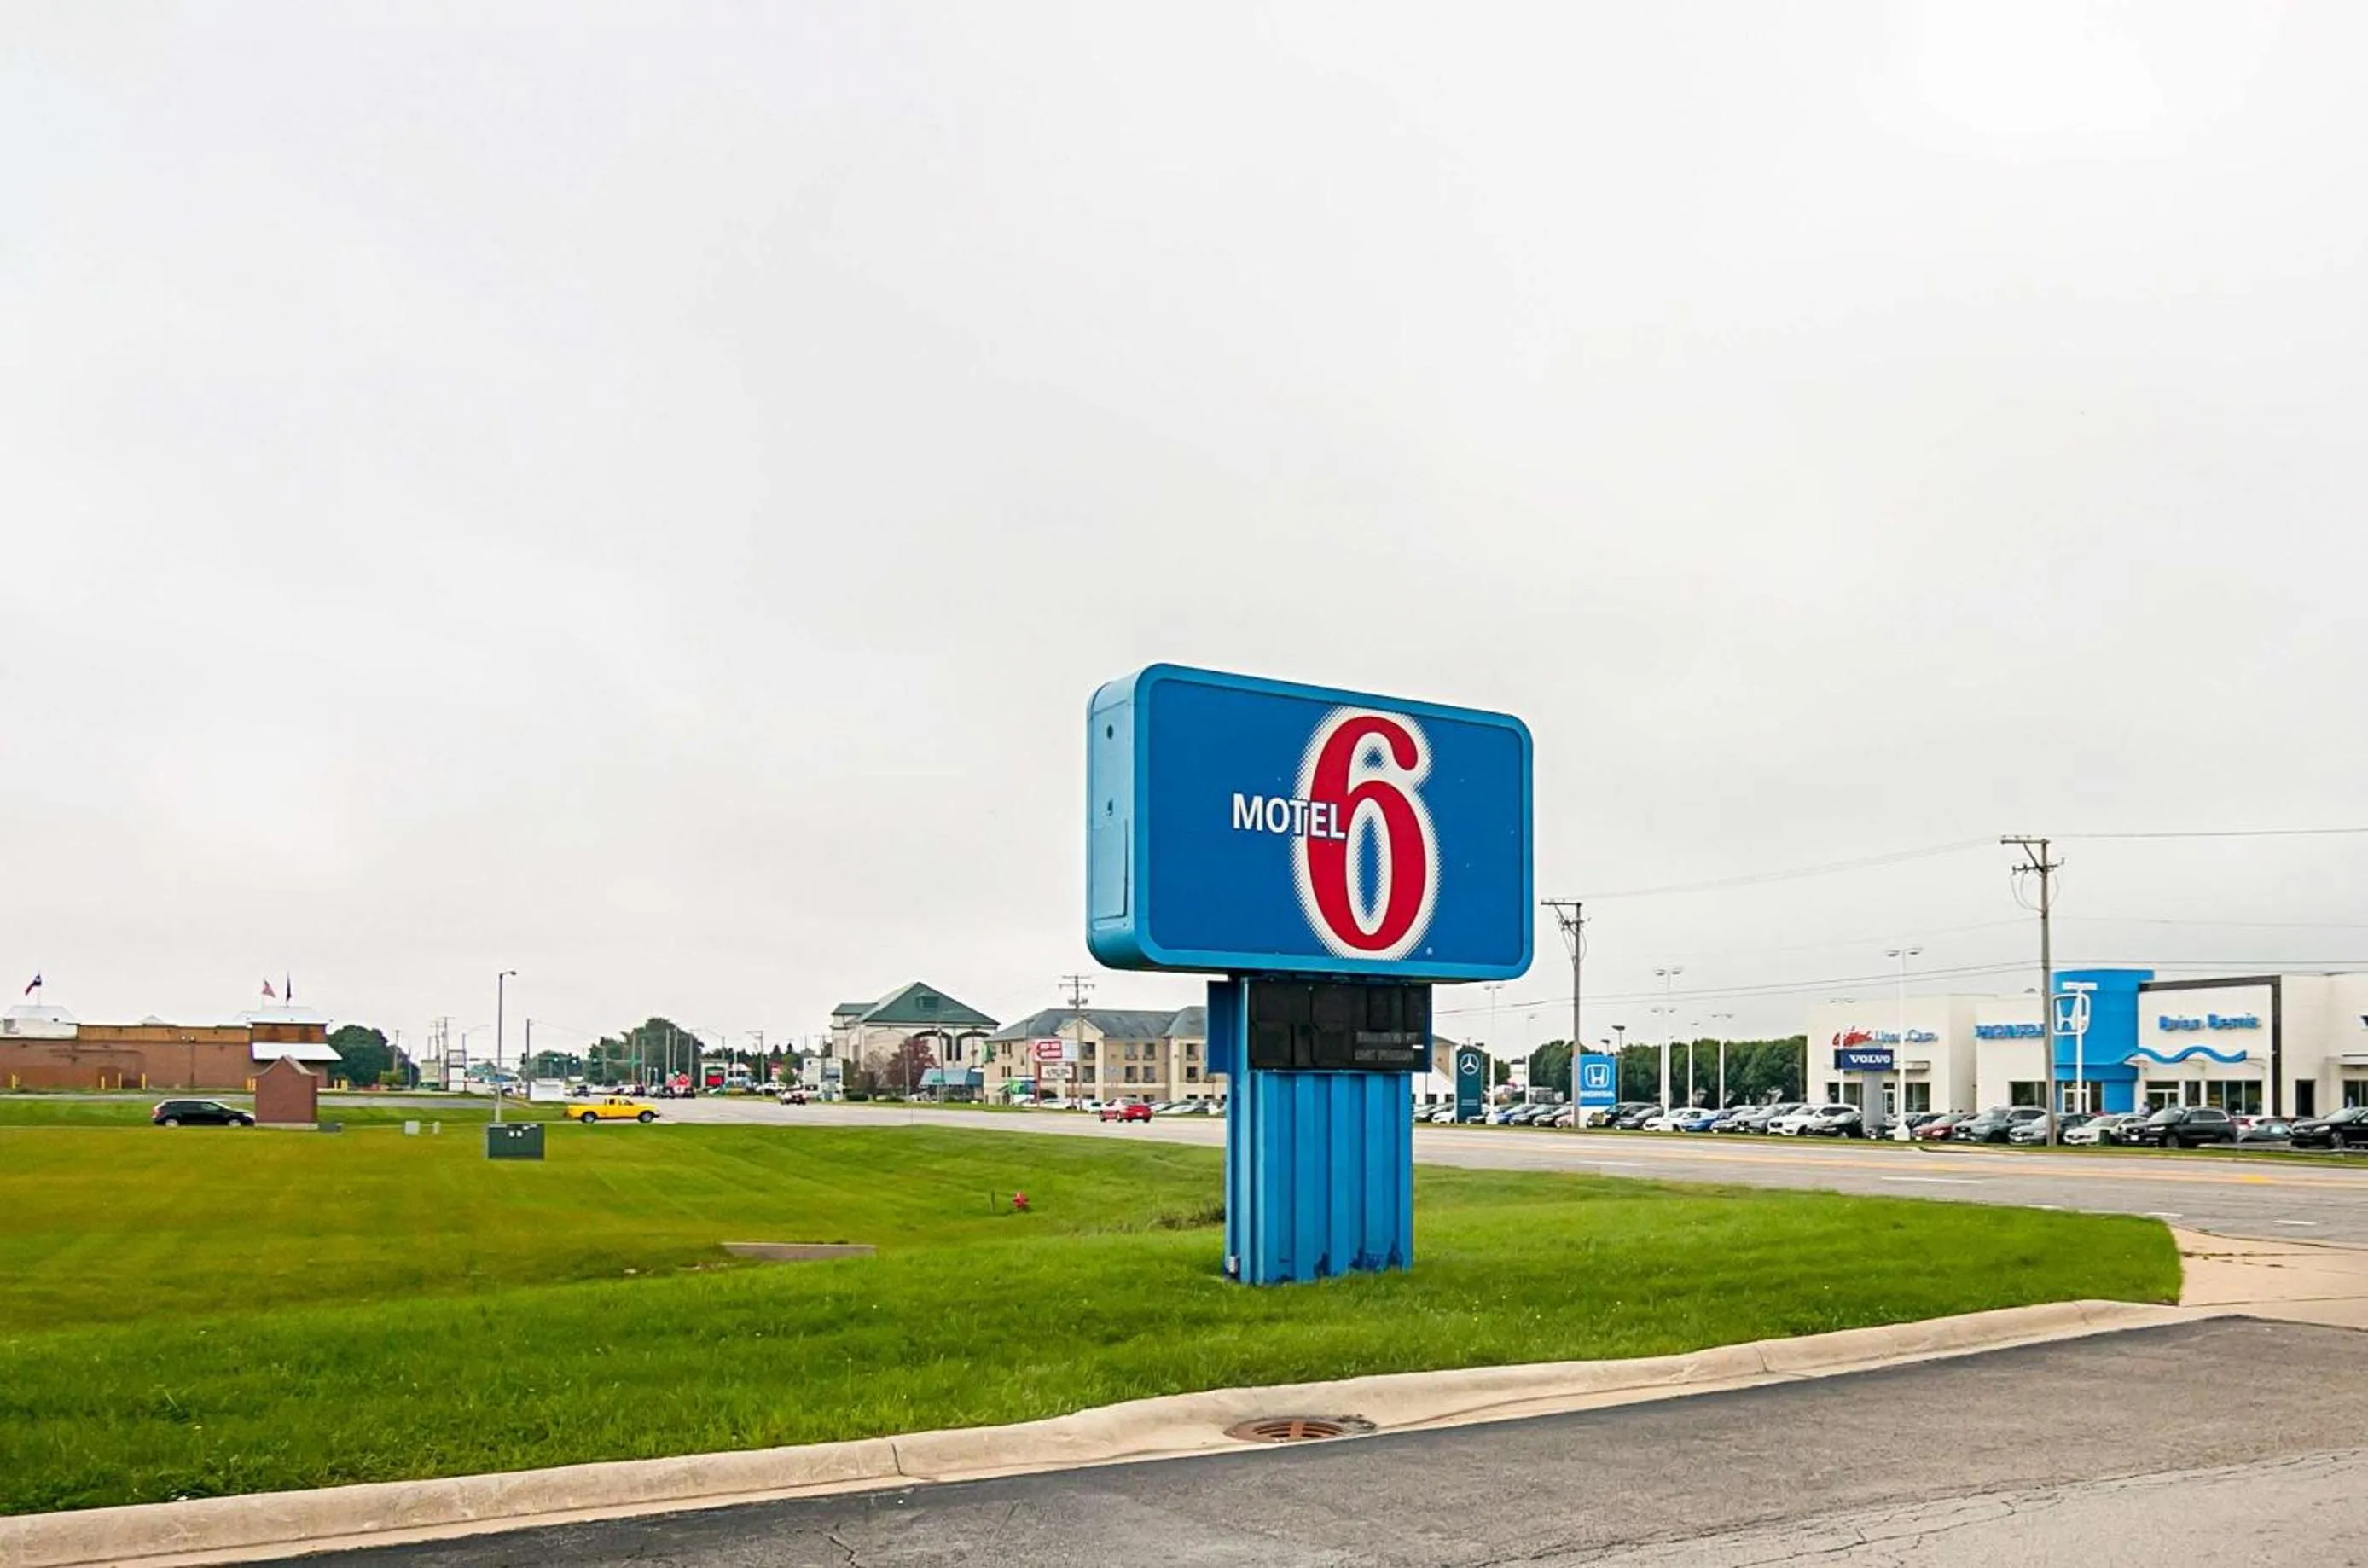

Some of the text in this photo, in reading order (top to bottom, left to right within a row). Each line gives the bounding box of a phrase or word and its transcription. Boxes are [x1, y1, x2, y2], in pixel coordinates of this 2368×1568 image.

[1233, 715, 1426, 952] MOTEL 6
[1849, 1054, 1891, 1064] VOLVO
